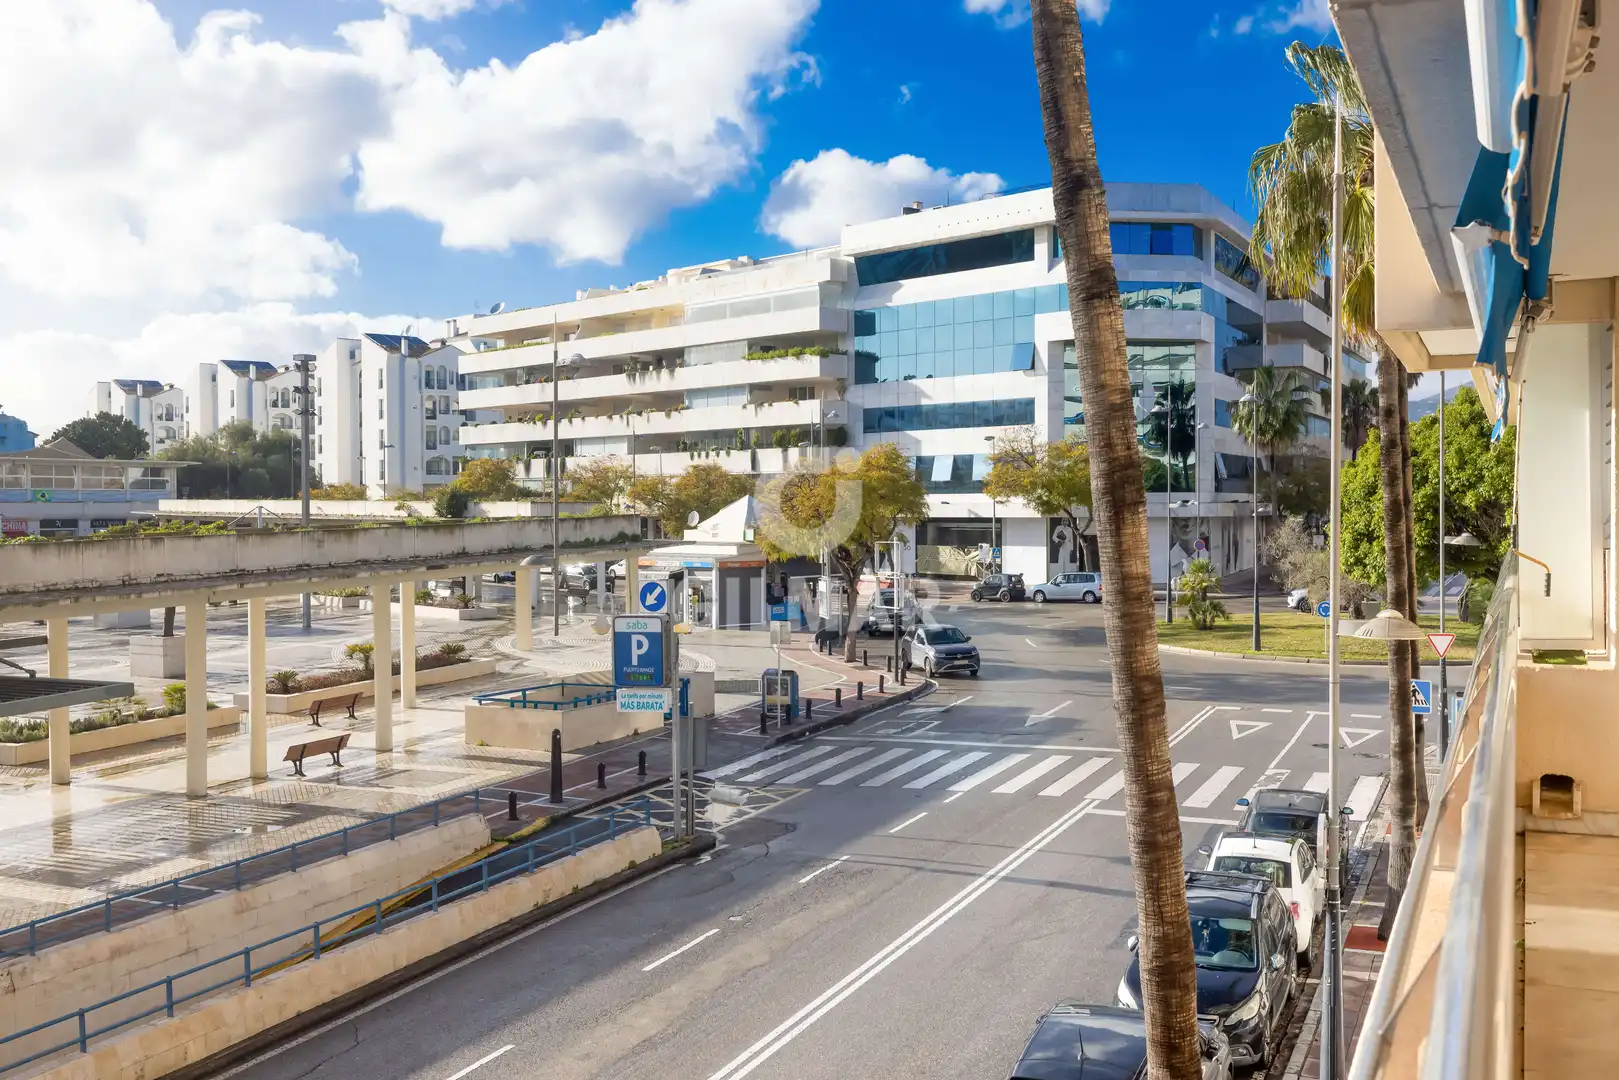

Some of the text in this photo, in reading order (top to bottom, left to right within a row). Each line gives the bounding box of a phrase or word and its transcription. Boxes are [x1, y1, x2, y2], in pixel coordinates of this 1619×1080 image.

[626, 620, 648, 630] saba
[631, 634, 649, 666] P
[620, 699, 635, 710] MÁS
